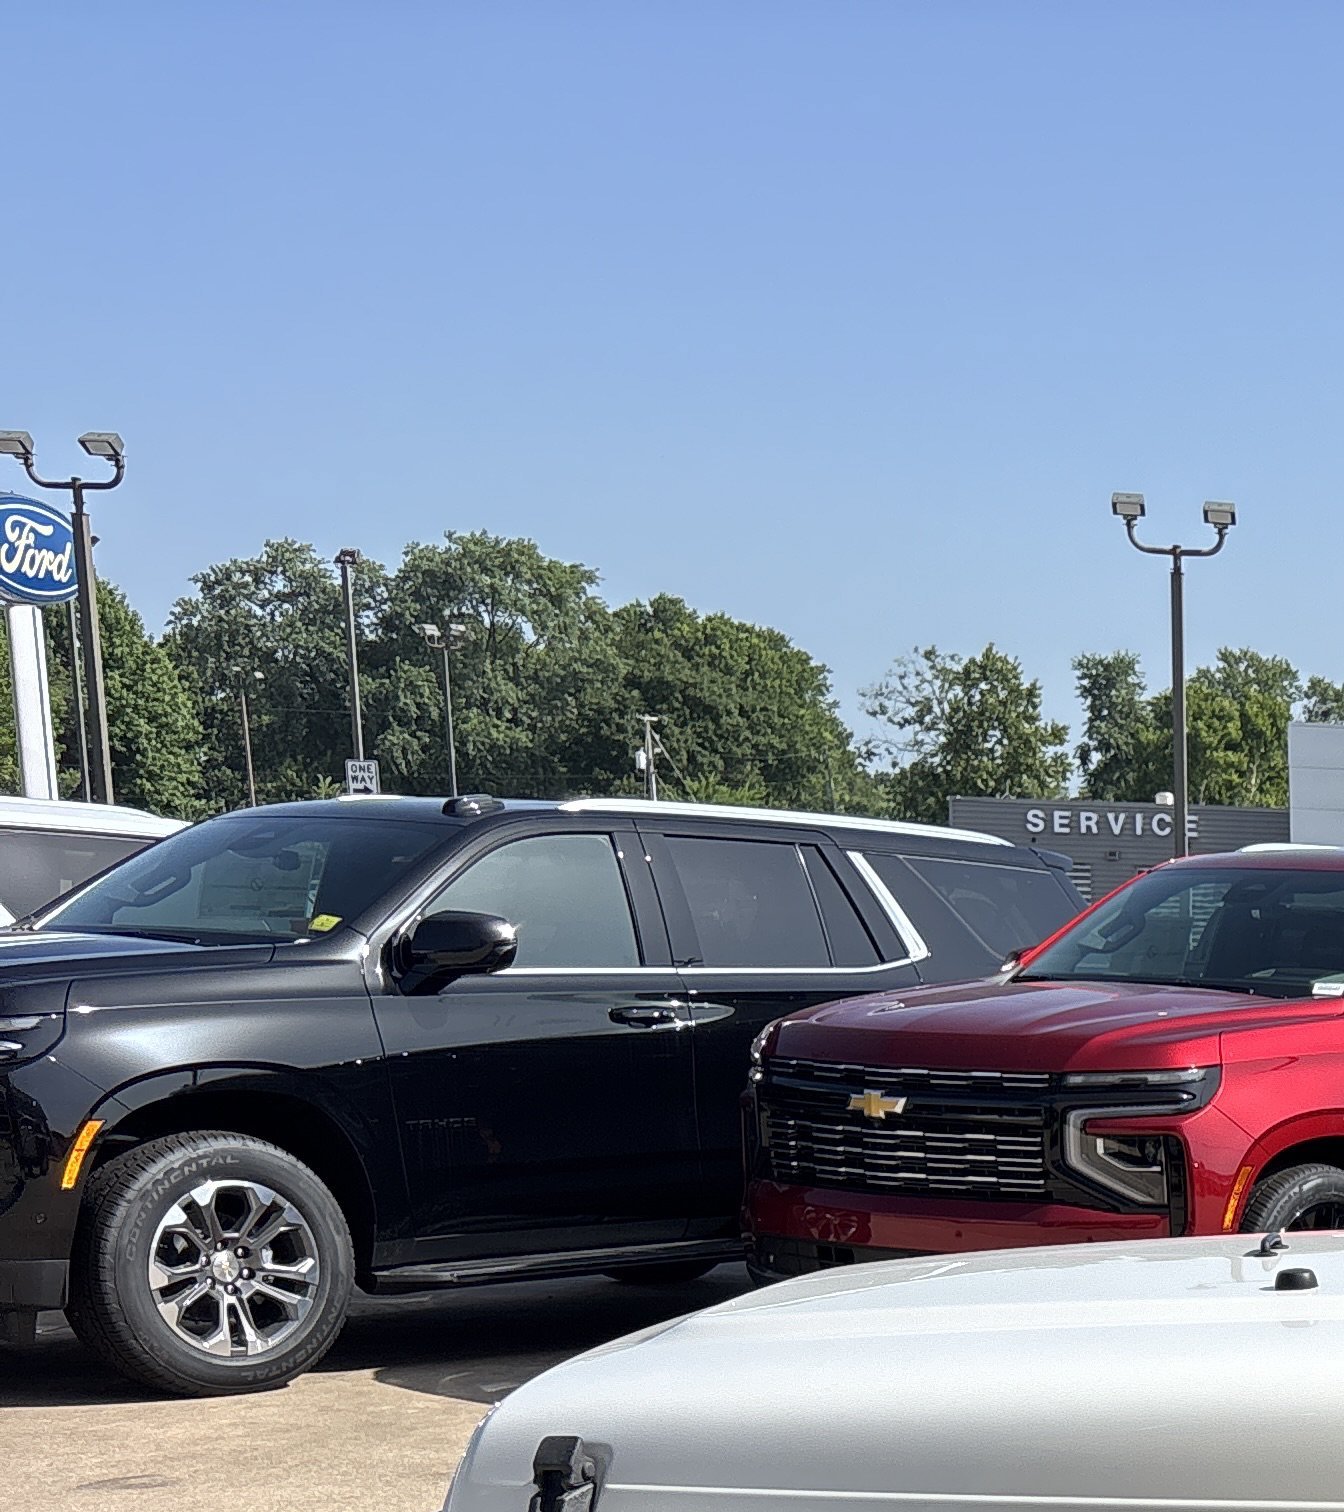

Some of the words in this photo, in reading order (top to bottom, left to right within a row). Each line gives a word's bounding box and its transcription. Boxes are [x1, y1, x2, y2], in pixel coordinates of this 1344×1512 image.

[0, 514, 72, 583] Ford
[350, 763, 374, 774] ONE
[350, 774, 375, 785] WAY
[1025, 809, 1199, 838] SERVICE
[126, 1156, 241, 1262] CONTINENTAL
